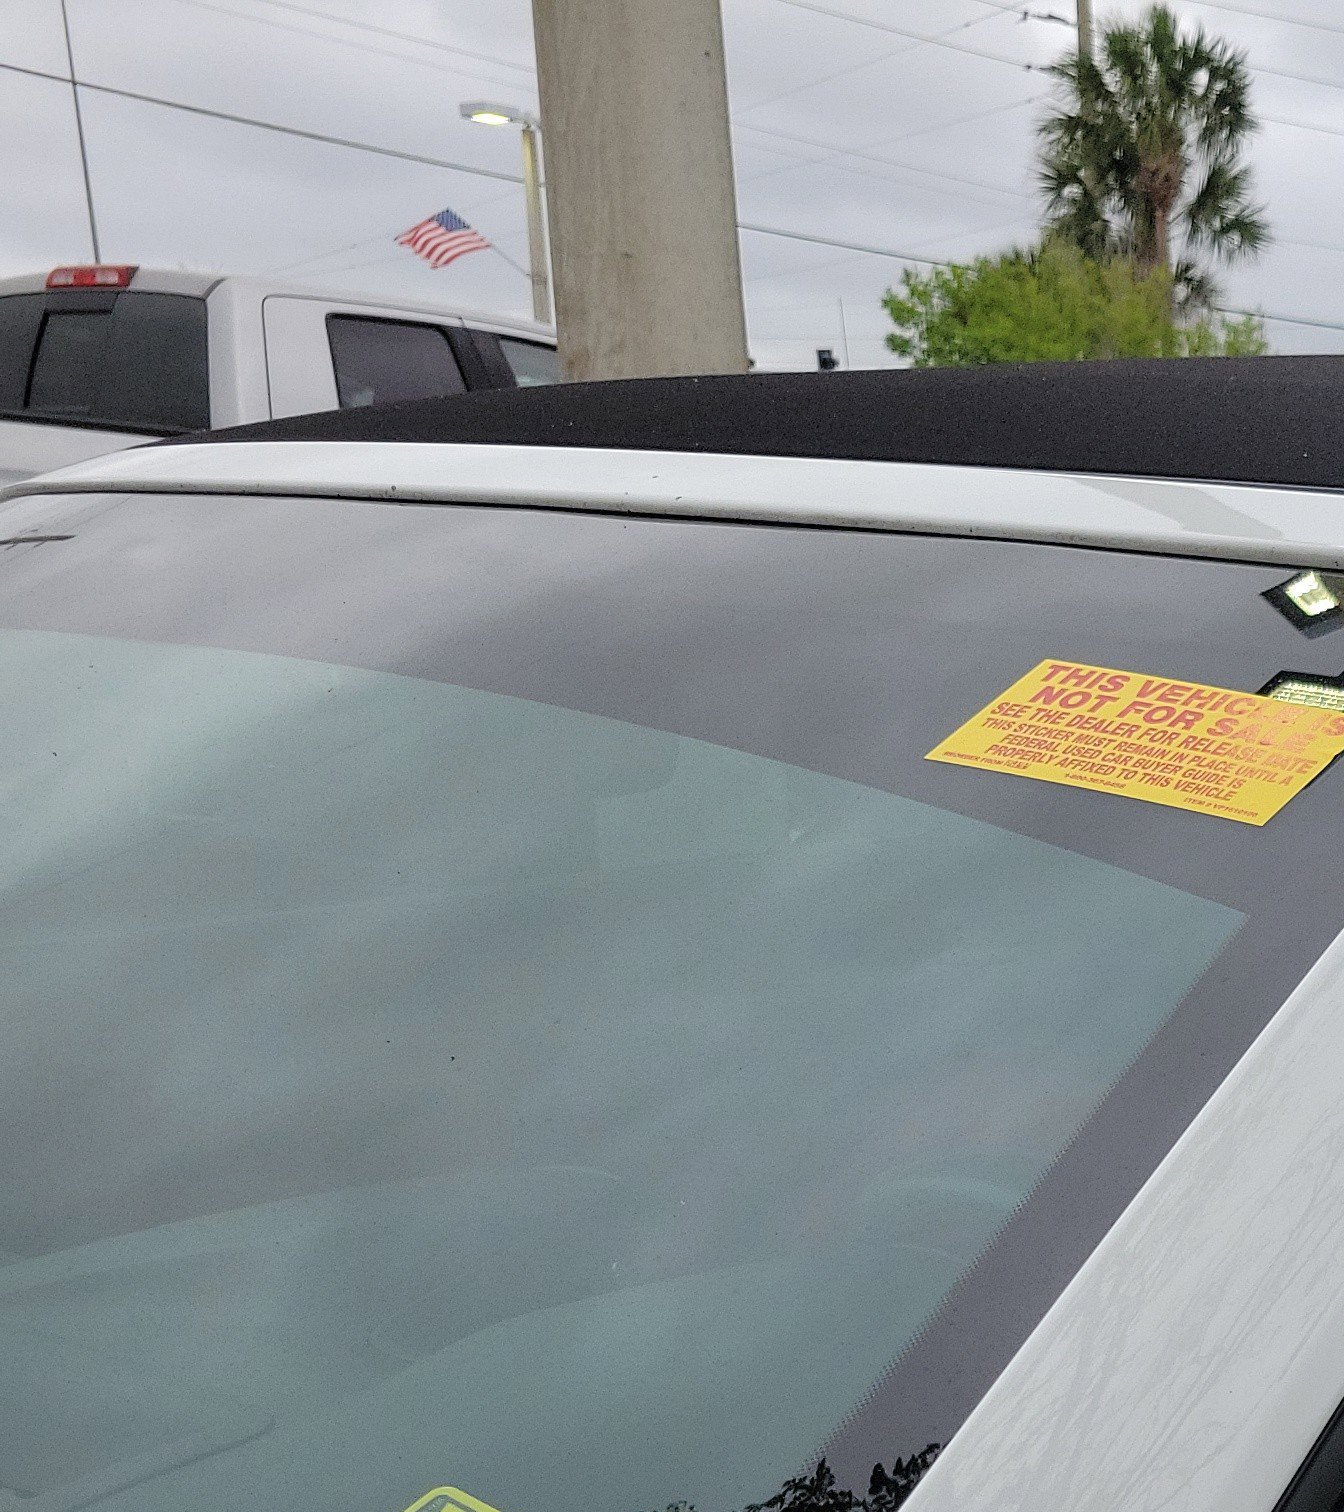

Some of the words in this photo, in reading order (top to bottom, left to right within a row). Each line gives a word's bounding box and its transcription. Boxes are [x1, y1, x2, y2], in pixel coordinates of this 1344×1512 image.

[1029, 686, 1119, 712] NOT
[1116, 701, 1204, 730] FOR
[1207, 718, 1317, 752] SALE
[1042, 665, 1130, 692] THIS
[1137, 680, 1306, 723] VEHICLE
[982, 718, 1015, 730] THIS
[1014, 724, 1075, 741] STICKER
[1072, 734, 1117, 748] MUST
[1113, 741, 1171, 759] REMAIN
[1169, 752, 1189, 763] IN
[1187, 756, 1233, 772] PLACE
[1235, 766, 1278, 782] UNTIL
[1280, 776, 1295, 786] A
[991, 702, 1031, 718] SEE
[1029, 708, 1070, 724] THE
[1065, 715, 1141, 738] DEALER
[1137, 728, 1181, 745] FOR
[1178, 735, 1265, 762] RELEASE
[1264, 754, 1318, 773] DATE
[1001, 734, 1060, 752] FEDERAL
[1062, 745, 1102, 759] USED
[1101, 753, 1133, 766] CAR
[1132, 758, 1183, 774] BUYER
[1182, 769, 1229, 785] GUIDE
[1228, 778, 1245, 788] IS
[985, 744, 1058, 764] PROPERLY
[1055, 757, 1116, 775] AFFIXED
[1117, 768, 1138, 779] TO
[1139, 773, 1173, 787] THIS
[1174, 780, 1236, 800] VEHICLE
